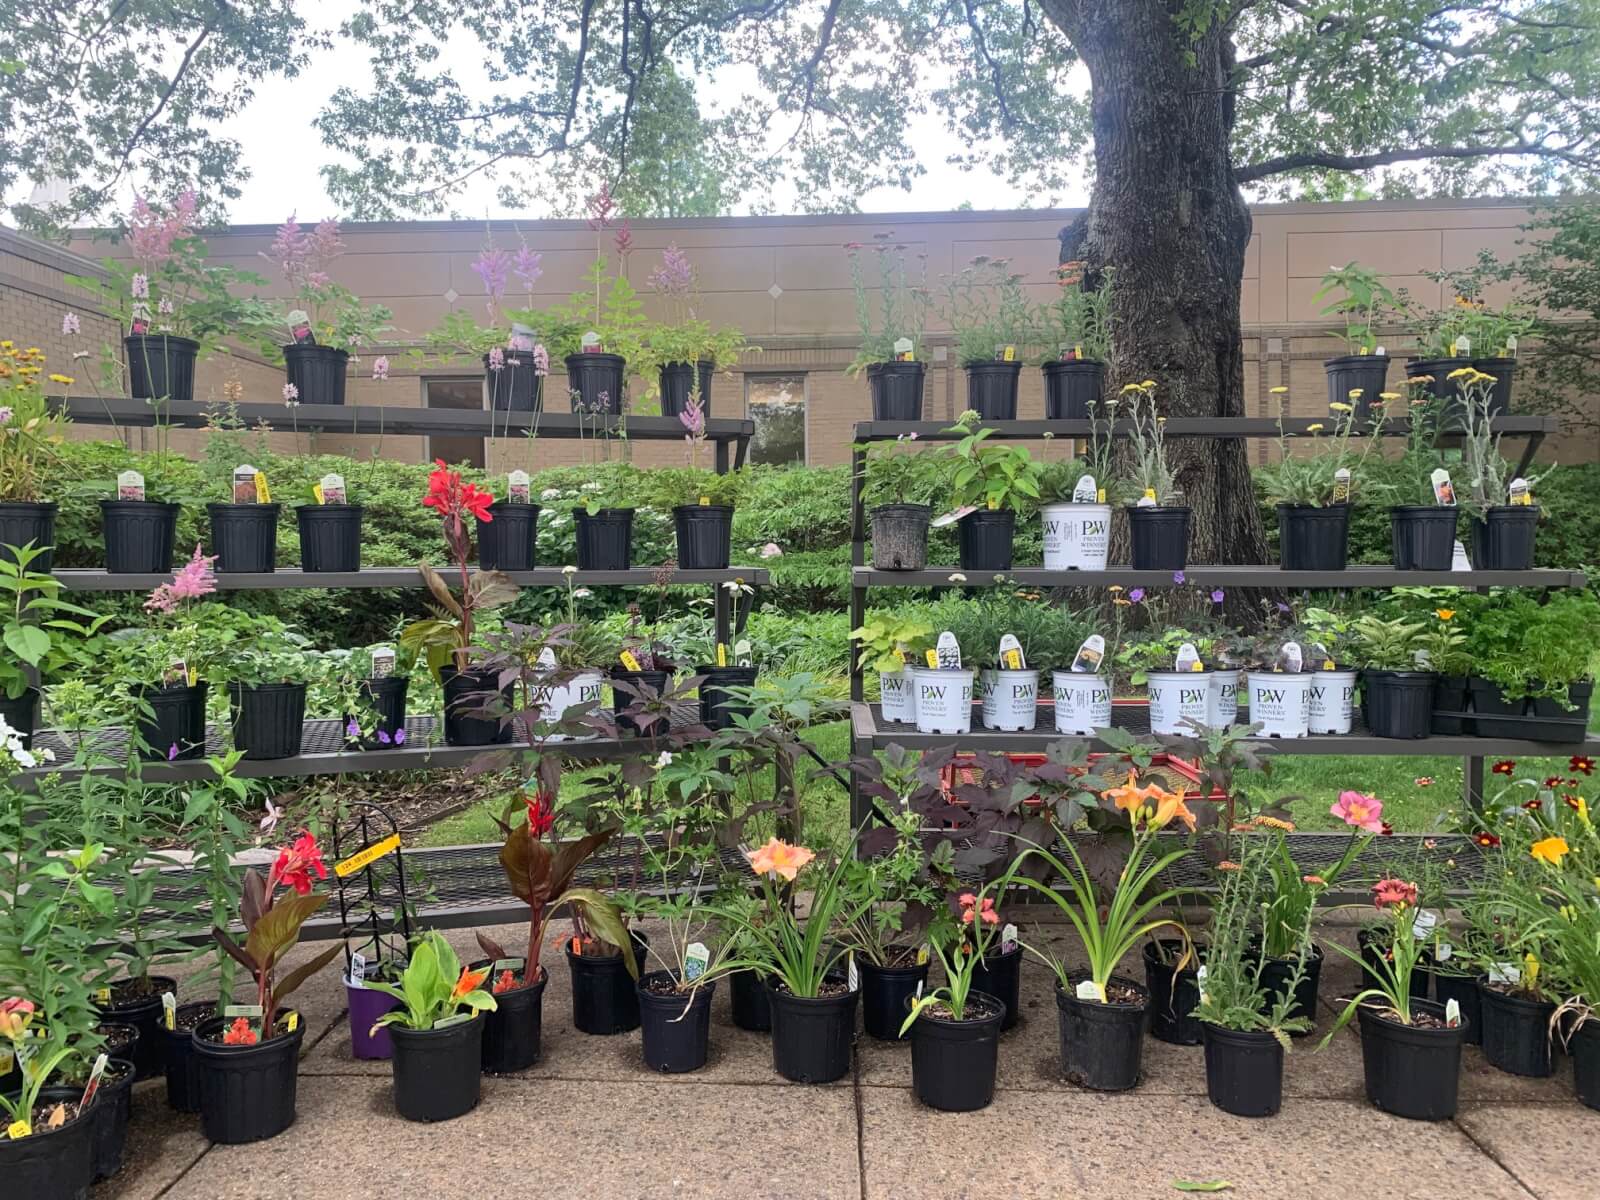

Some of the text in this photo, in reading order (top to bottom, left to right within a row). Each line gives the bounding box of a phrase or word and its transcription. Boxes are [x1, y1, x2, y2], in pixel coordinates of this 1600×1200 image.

[1080, 520, 1108, 536] PW
[883, 678, 905, 691] PW
[921, 685, 948, 700] PW
[1012, 683, 1036, 699] PW
[578, 684, 601, 702] PW
[1180, 688, 1207, 704] PW
[1256, 688, 1286, 704] PW
